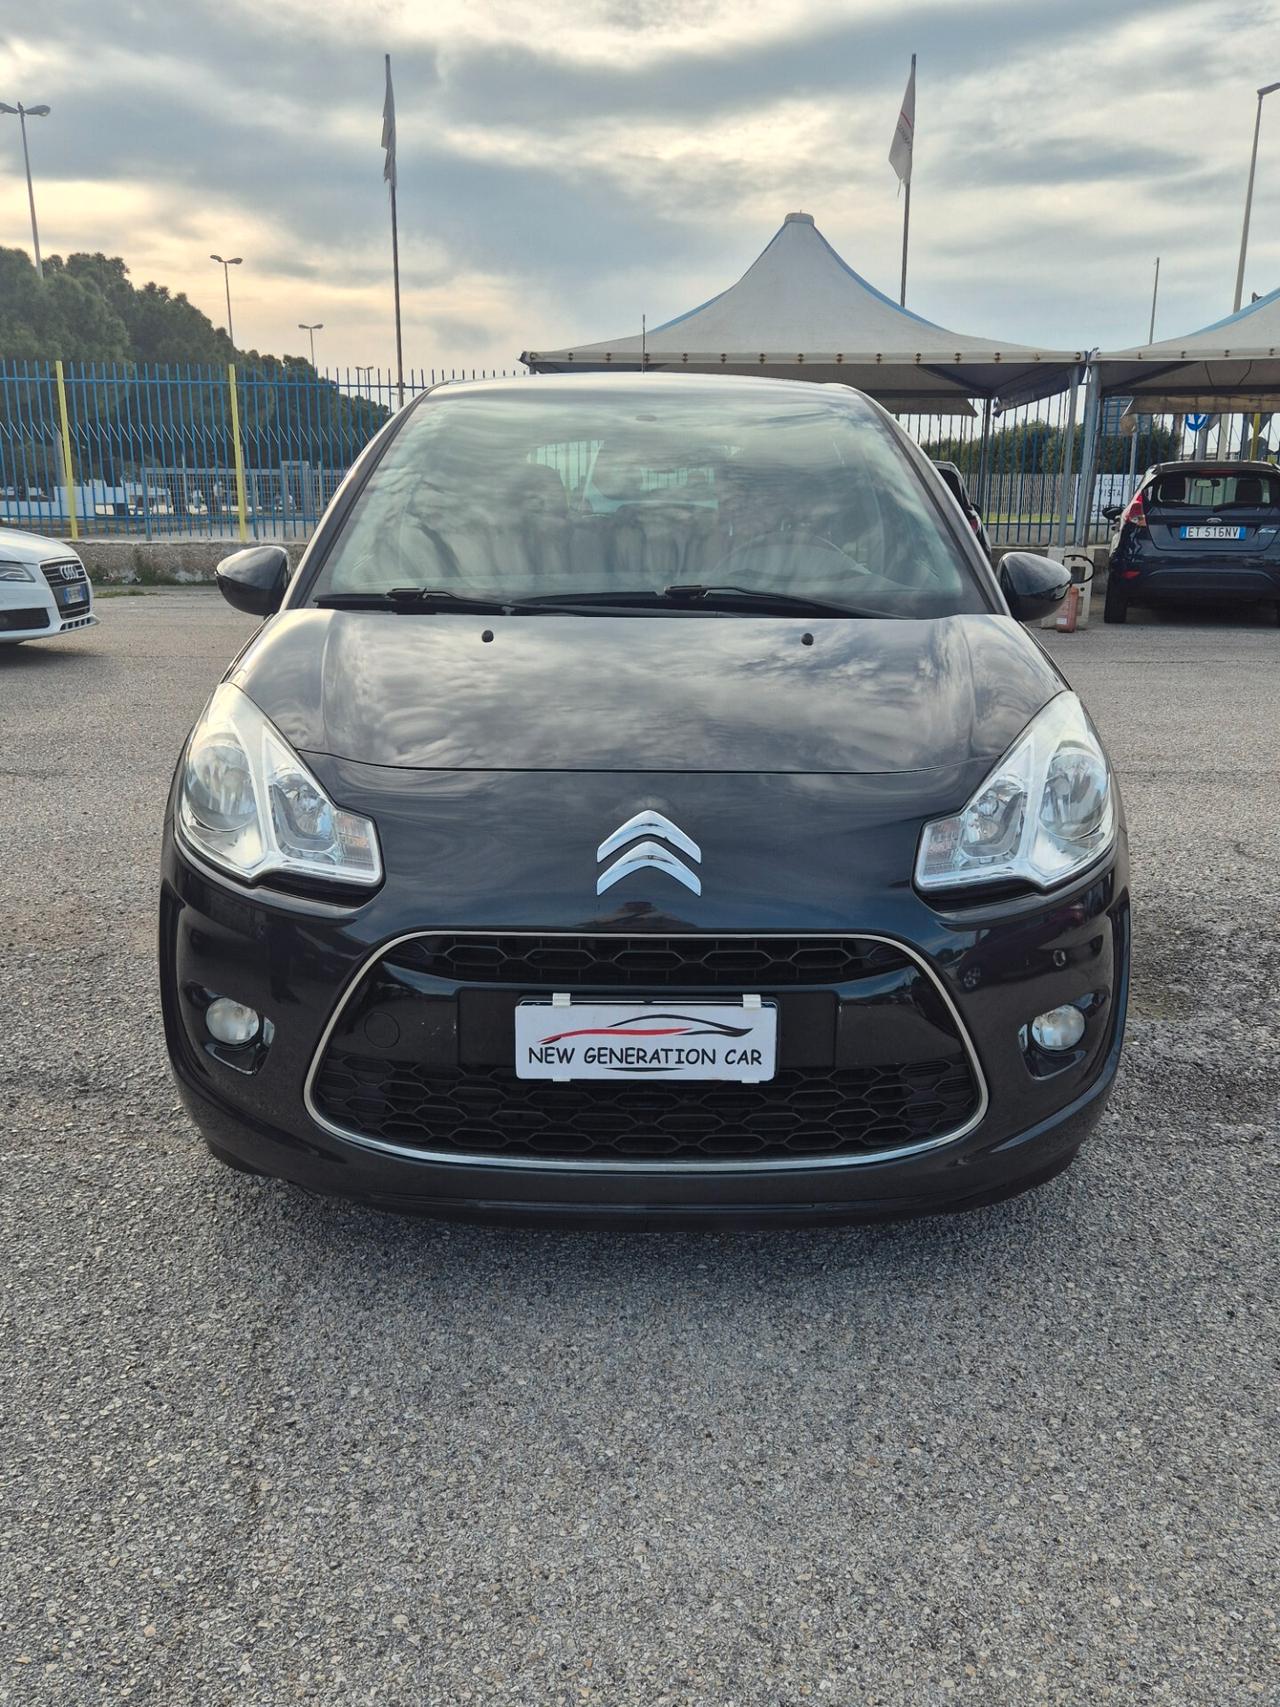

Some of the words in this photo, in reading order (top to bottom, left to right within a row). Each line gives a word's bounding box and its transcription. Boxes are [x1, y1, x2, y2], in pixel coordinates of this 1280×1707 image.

[1188, 526, 1200, 537] ET
[1204, 526, 1239, 537] 516NV
[528, 1047, 575, 1064] NEW
[583, 1047, 716, 1065] GENERATION
[725, 1049, 762, 1065] CAR
